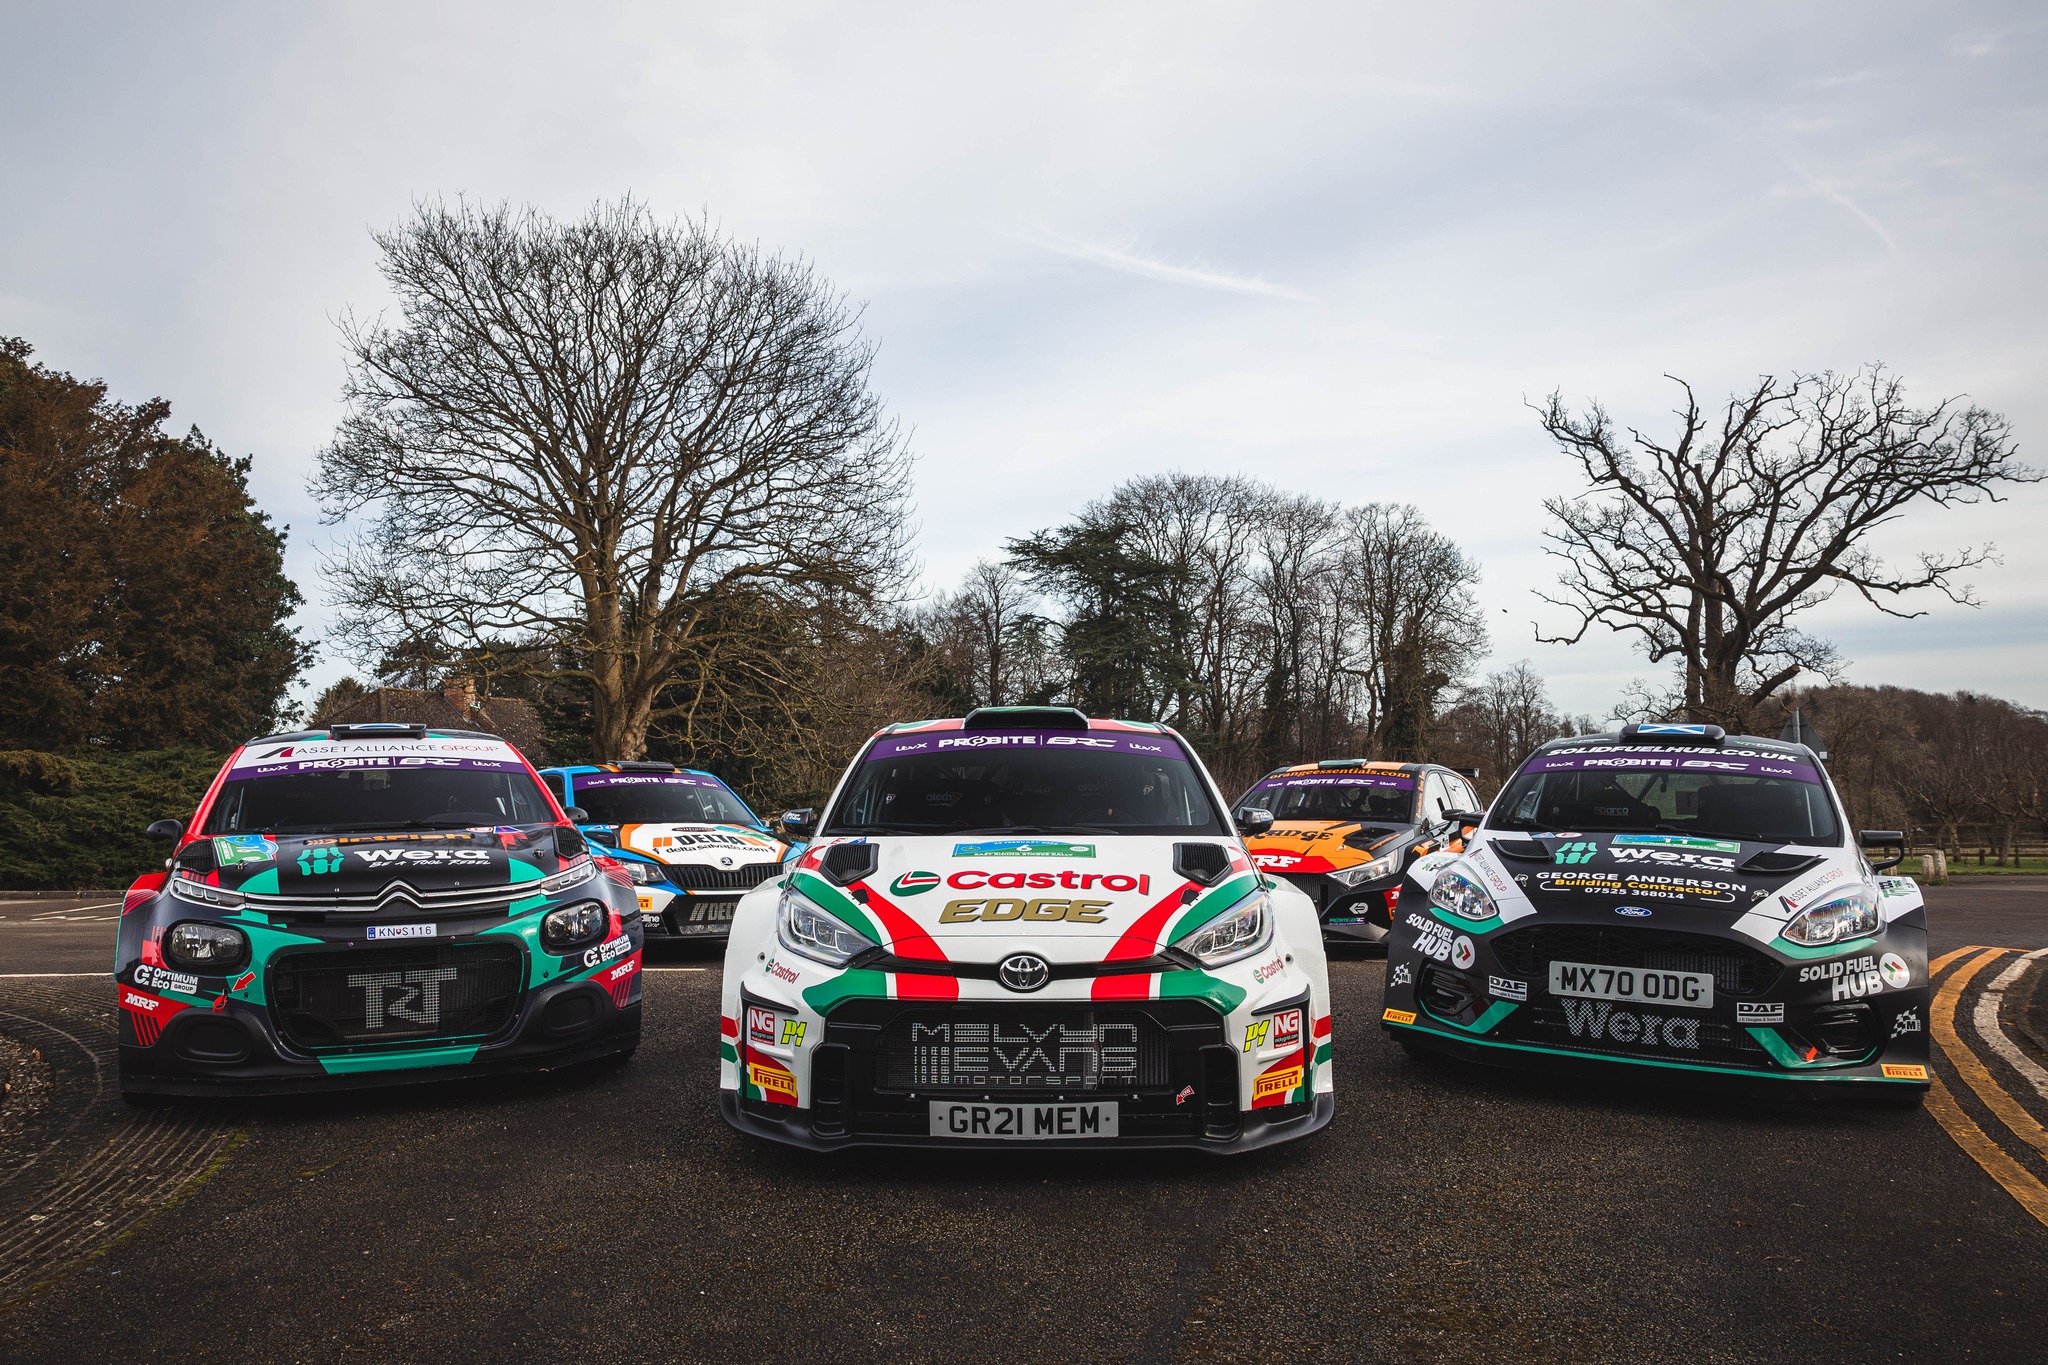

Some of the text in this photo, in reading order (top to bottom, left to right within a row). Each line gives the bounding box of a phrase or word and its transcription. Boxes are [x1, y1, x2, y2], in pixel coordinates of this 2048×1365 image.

[295, 746, 349, 755] ASSET
[441, 744, 498, 752] GROUP
[938, 736, 1036, 748] PROBITE
[1546, 745, 1799, 762] SOLIDFUELHUB.CO.UK
[1583, 758, 1673, 767] PROBITE
[299, 757, 389, 770] PROBITE
[1269, 768, 1411, 779] orangeessentials.com
[675, 834, 746, 846] DELTA
[1016, 844, 1032, 852] 6
[354, 849, 490, 862] Wera
[1252, 855, 1302, 868] RF
[1607, 848, 1735, 867] Wera
[946, 870, 1151, 896] Castrol
[1536, 872, 1747, 892] GEORGE ANDERSON
[1555, 879, 1722, 896] Building Contractor
[1584, 887, 1685, 899] 07525 368014
[1789, 888, 1810, 903] ASSET
[938, 898, 1114, 924] EDGE
[1406, 913, 1454, 944] SOLID FUEL
[600, 934, 630, 952] OPTIMUM
[1412, 931, 1452, 961] HUB
[153, 967, 199, 985] OPTIMUM
[611, 960, 635, 981] MRF
[770, 961, 801, 985] Castrol
[1260, 956, 1285, 981] Castrol
[1799, 955, 1878, 983] SOLID FUEL
[173, 984, 194, 992] GROUP
[1490, 977, 1526, 990] DAF
[1560, 966, 1700, 1002] MX70 ODG
[1832, 970, 1884, 1001] HUB
[125, 993, 160, 1011] MRF
[1738, 1004, 1783, 1013] DAF
[751, 1009, 774, 1033] NG
[1274, 1011, 1298, 1036] NG
[1386, 1010, 1413, 1022] PIRELLI
[1560, 998, 1700, 1050] Wera
[754, 1067, 794, 1093] PIRELLI
[1886, 1066, 1923, 1077] PIRELLI
[1256, 1070, 1298, 1095] PIRELLI
[948, 1105, 1100, 1135] GR21 MEM
